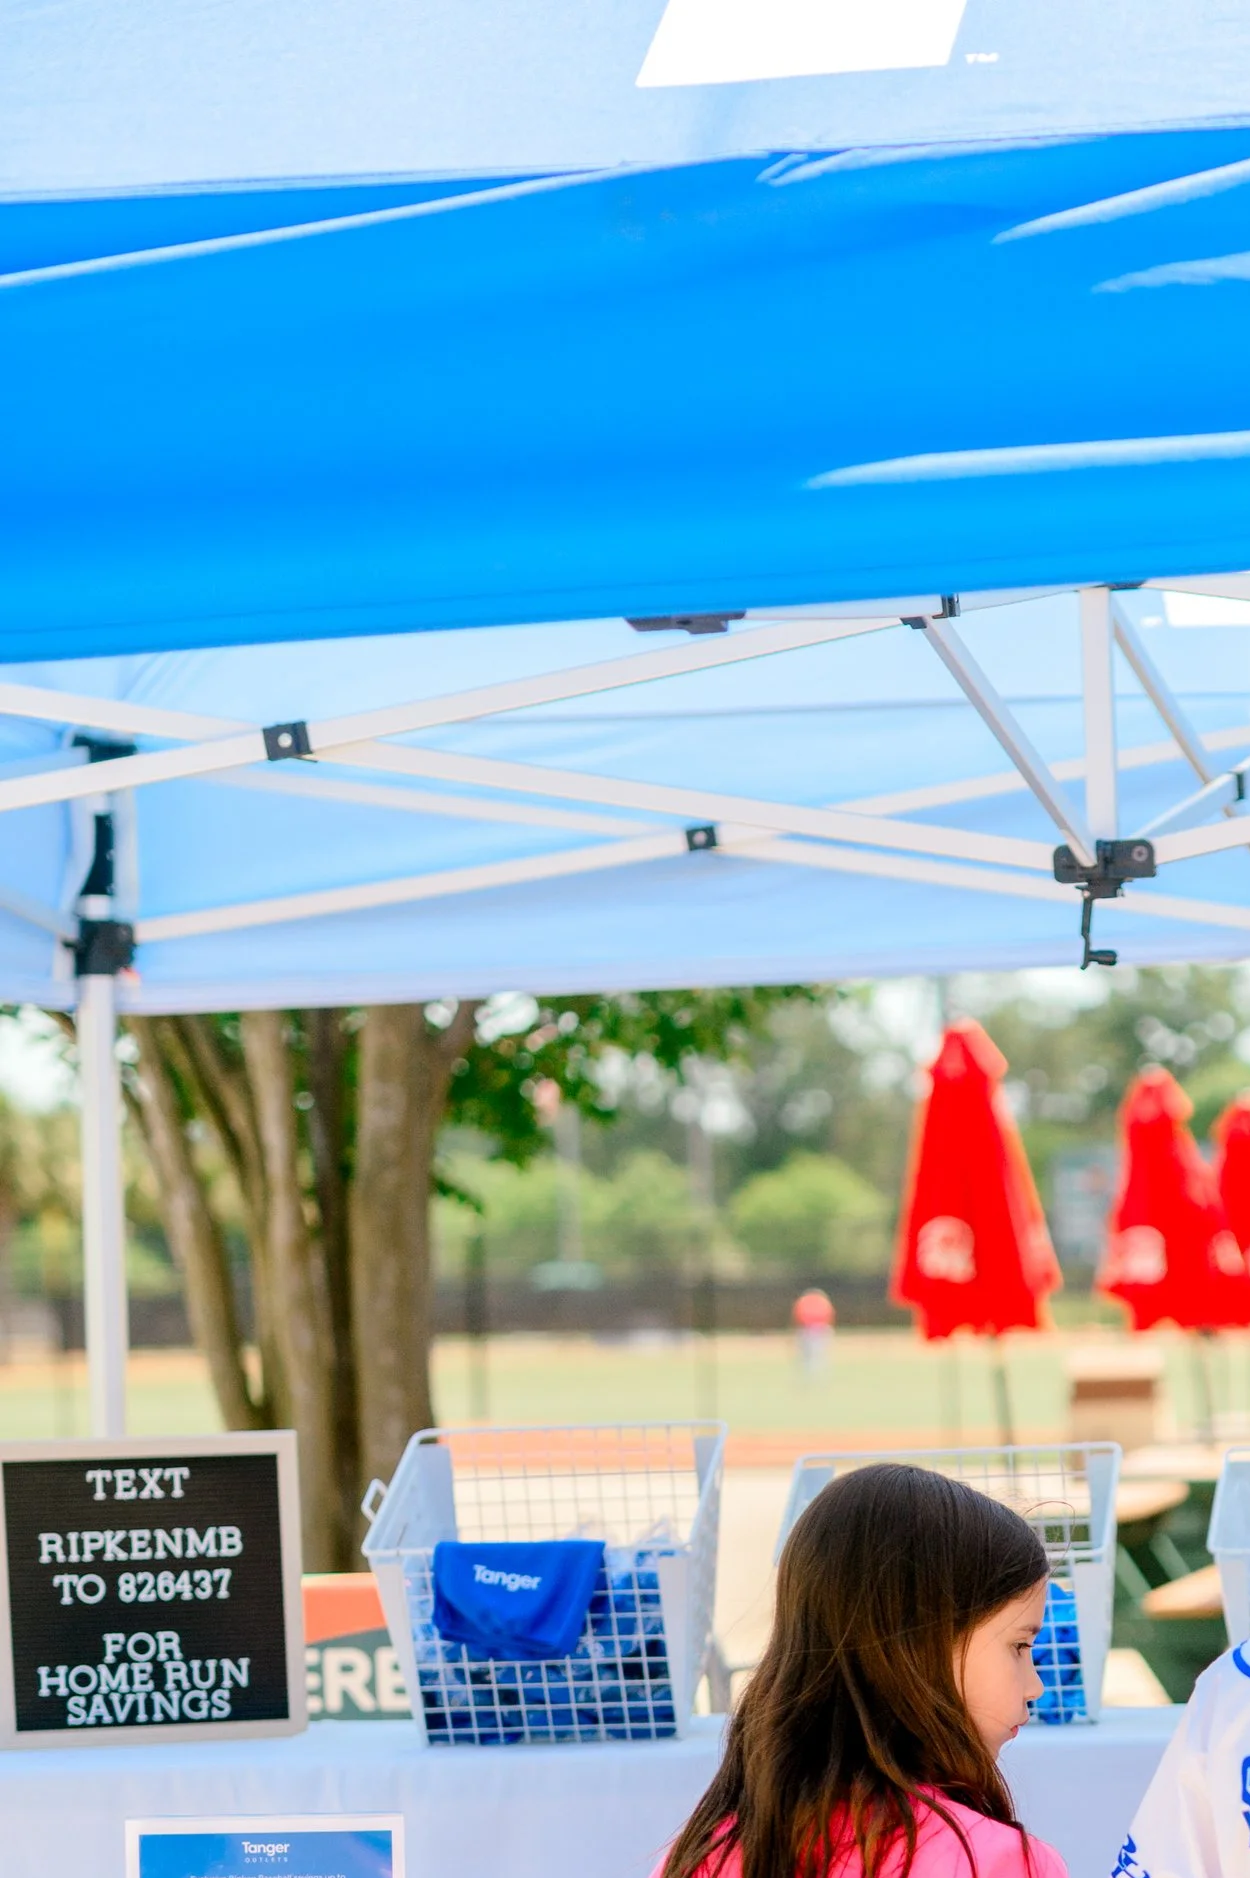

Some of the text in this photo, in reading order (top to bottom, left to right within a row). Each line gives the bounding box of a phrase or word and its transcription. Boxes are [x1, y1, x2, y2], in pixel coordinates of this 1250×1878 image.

[86, 1466, 190, 1501] TEXT
[38, 1526, 244, 1563] RIPKENMB
[53, 1568, 232, 1605] TO 826437
[473, 1564, 542, 1592] Tanger
[103, 1630, 183, 1664] FOR
[37, 1657, 250, 1697] HOME RUN
[66, 1689, 231, 1726] SAVINGS
[241, 1841, 290, 1857] Tanger
